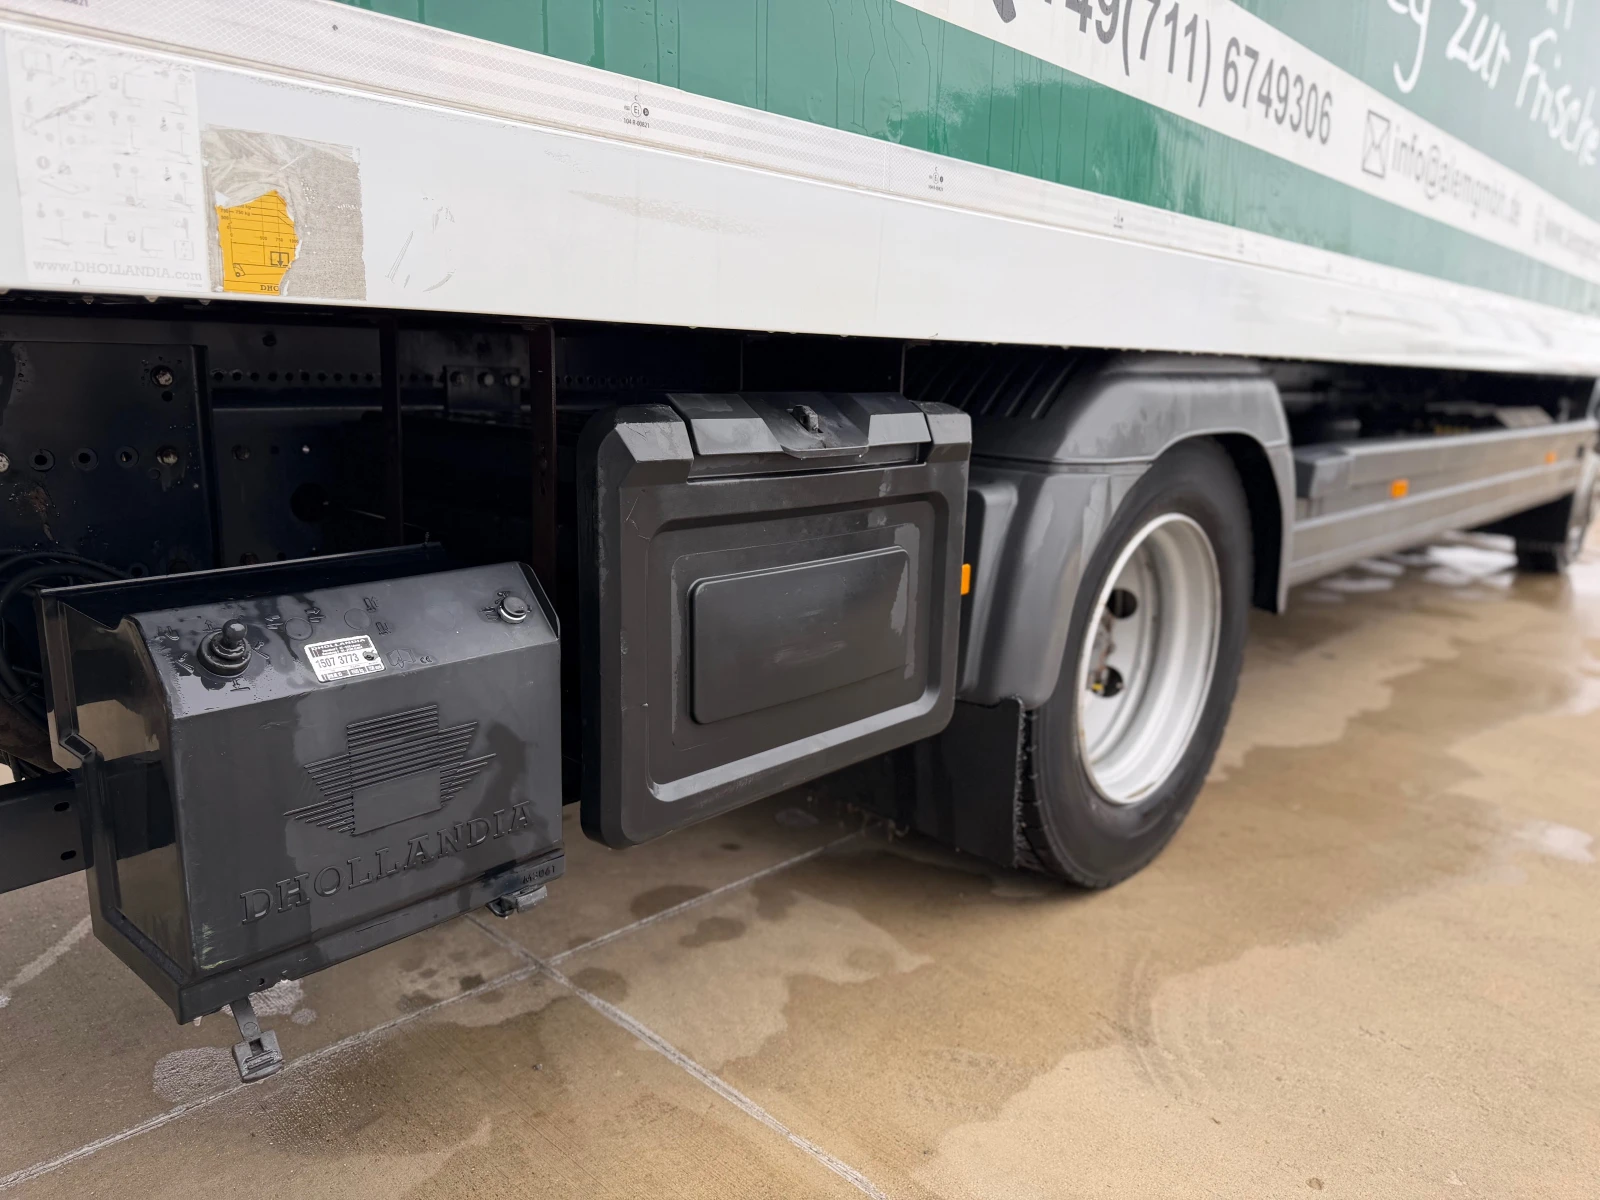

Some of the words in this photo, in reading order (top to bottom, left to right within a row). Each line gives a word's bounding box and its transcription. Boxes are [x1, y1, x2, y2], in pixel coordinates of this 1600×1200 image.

[1045, 0, 1211, 107] 9(711)
[1223, 37, 1332, 145] 6749306
[33, 261, 203, 281] www.DHOLLANDIA.com
[311, 638, 366, 651] DHOLLANDIA
[316, 657, 336, 669] 1507
[338, 653, 360, 665] 3773
[240, 801, 533, 925] DHOLLANDIA
